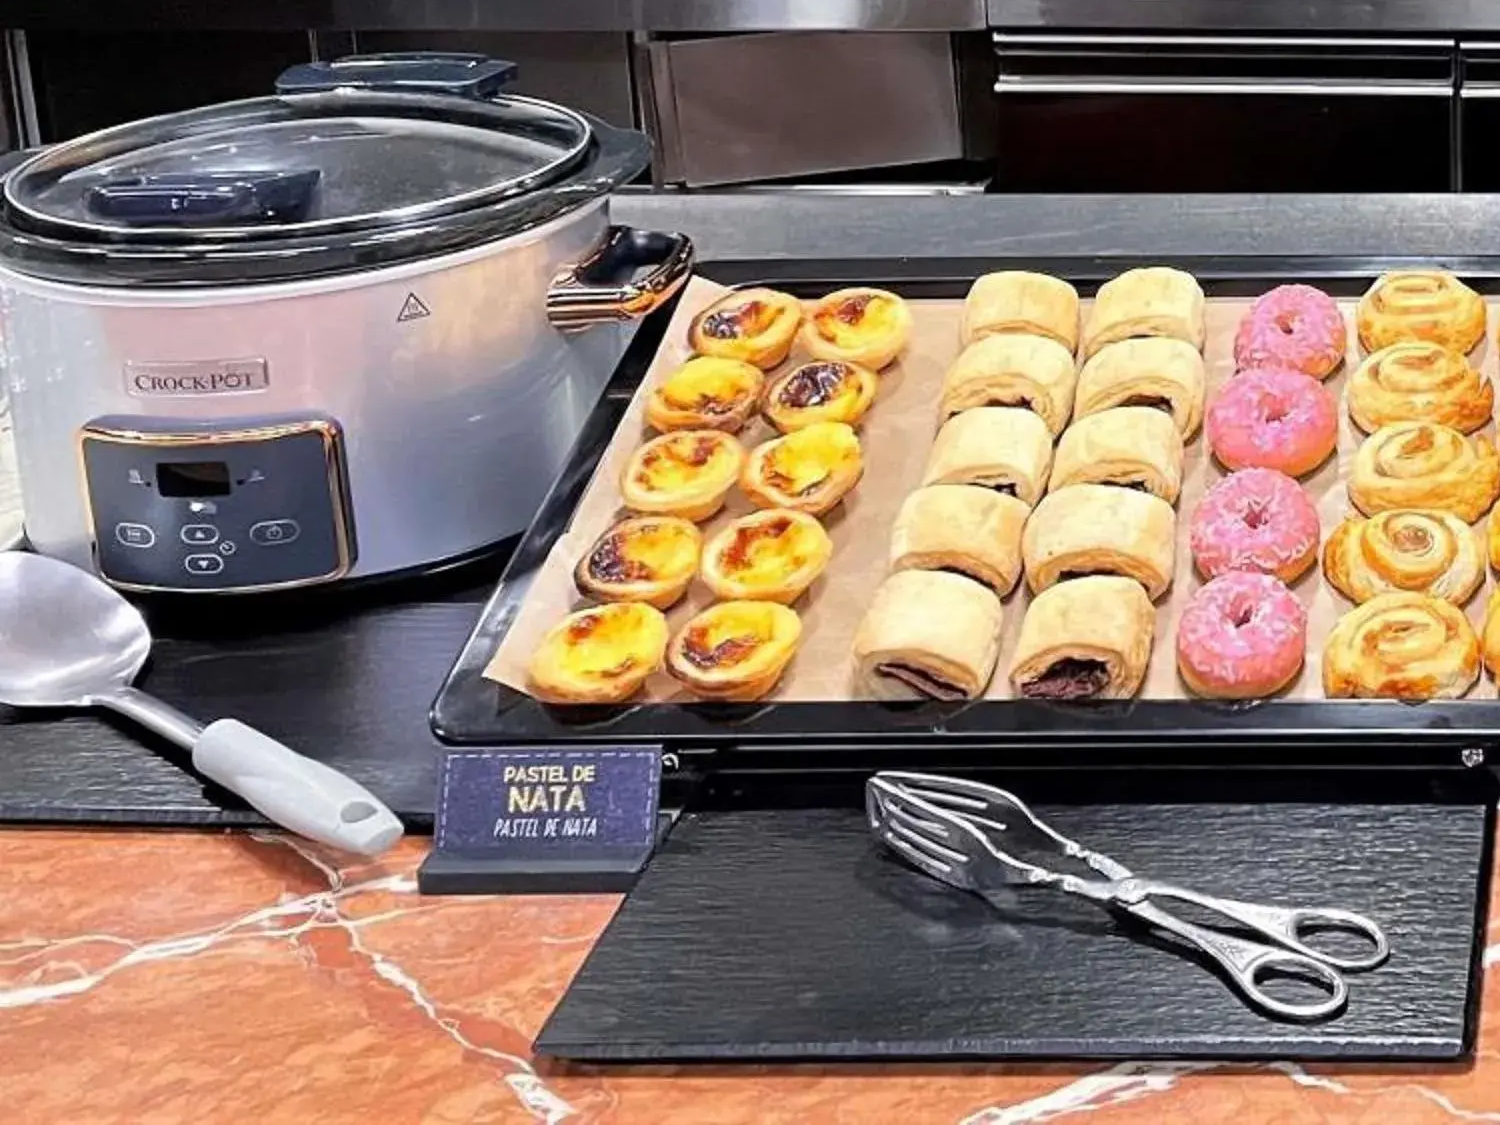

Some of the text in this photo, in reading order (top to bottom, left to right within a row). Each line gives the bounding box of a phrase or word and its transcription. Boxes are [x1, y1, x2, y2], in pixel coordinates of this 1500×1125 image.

[503, 764, 596, 783] PASTEL DE
[507, 785, 587, 813] NATA
[493, 818, 597, 837] PASTEL DE NATA
